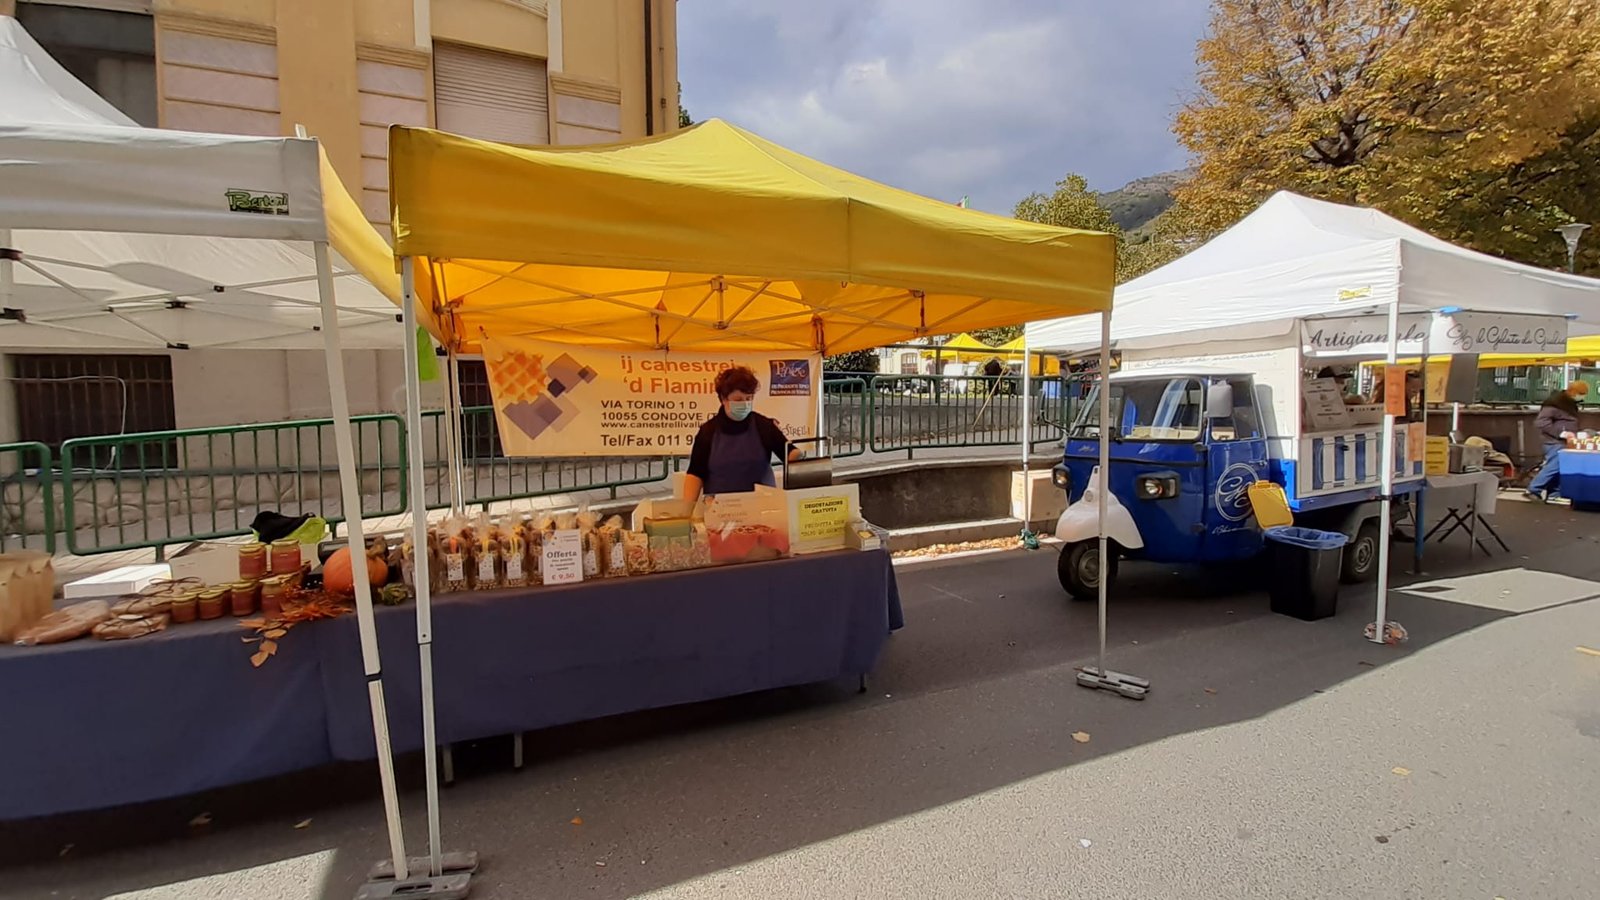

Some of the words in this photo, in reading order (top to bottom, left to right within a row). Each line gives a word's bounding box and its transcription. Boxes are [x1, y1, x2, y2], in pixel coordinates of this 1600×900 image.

[621, 355, 633, 373] ij
[601, 400, 623, 409] VIA
[626, 400, 675, 409] TORINO
[679, 401, 685, 409] 1
[689, 401, 697, 409] D
[601, 412, 638, 421] 10055
[641, 412, 702, 421] CONDOVE
[600, 434, 653, 446] Tel/Fax
[657, 434, 680, 446] 011
[546, 551, 577, 559] Offerta
